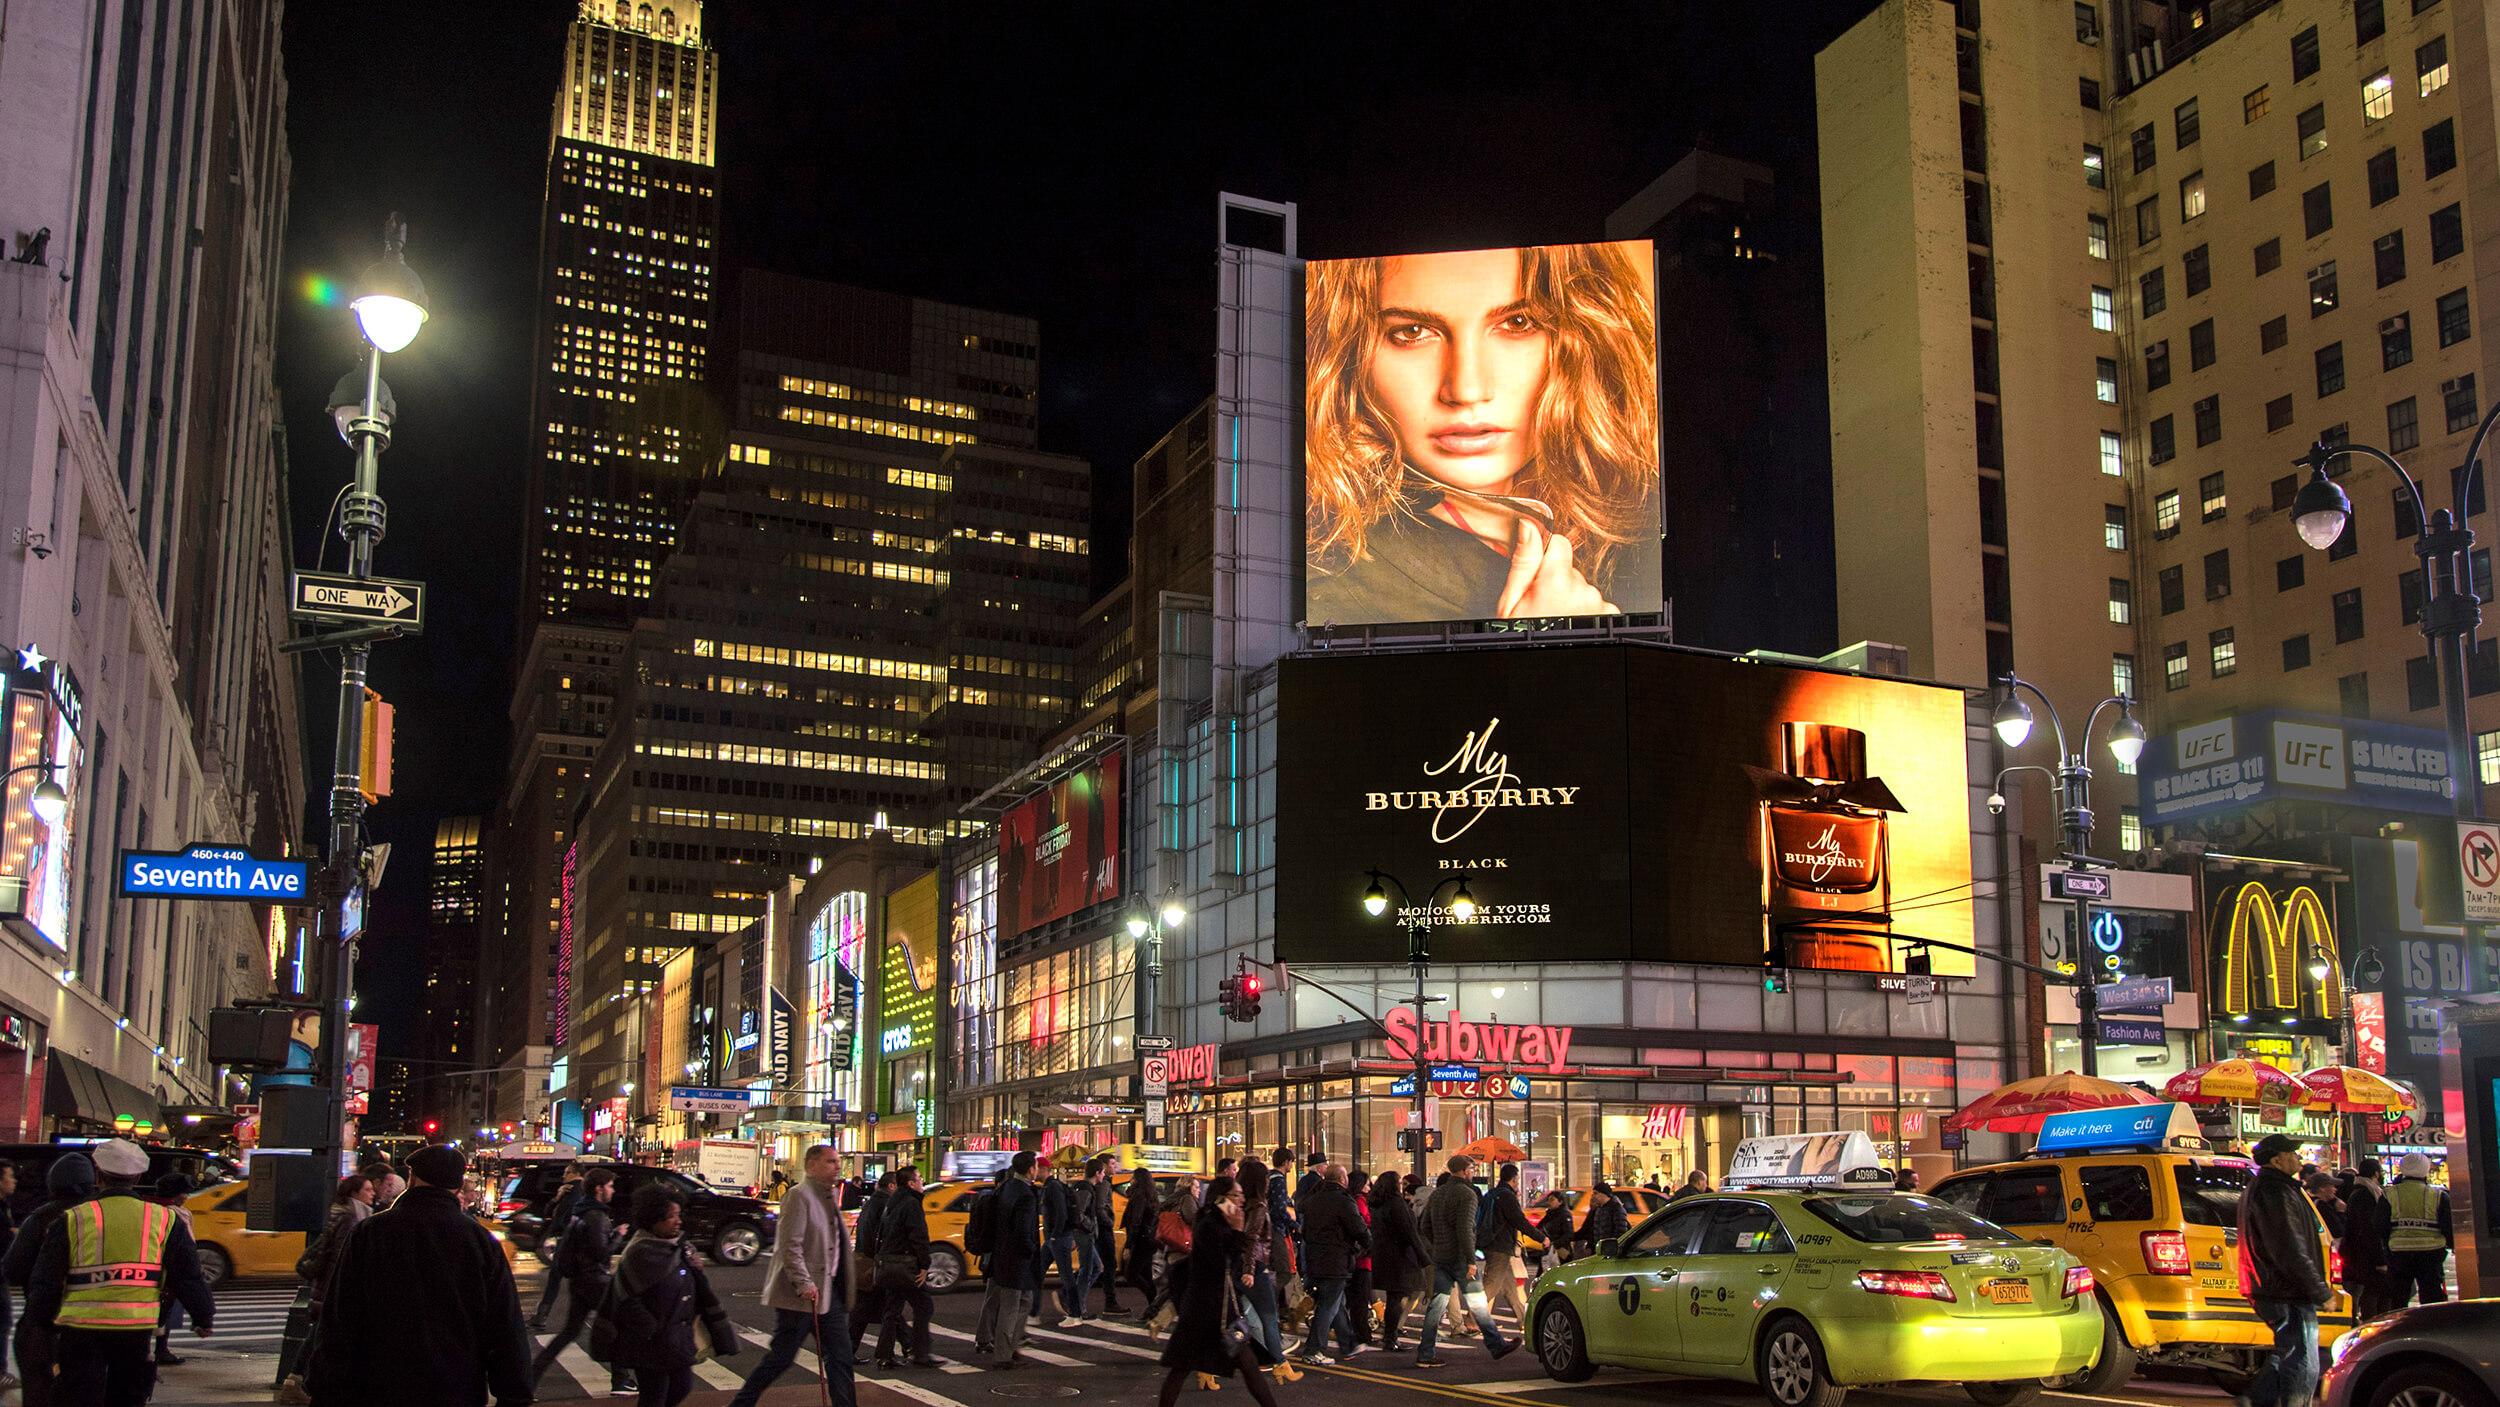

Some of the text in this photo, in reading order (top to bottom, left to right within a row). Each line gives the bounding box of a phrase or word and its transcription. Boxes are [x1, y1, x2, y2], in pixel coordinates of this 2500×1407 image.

[316, 588, 401, 609] ONE WAY
[2185, 733, 2226, 759] UFC
[2285, 741, 2334, 770] UFC
[2352, 740, 2370, 767] IS
[2371, 743, 2416, 773] BACK
[1423, 716, 1521, 844] My
[2155, 778, 2171, 800] IS
[2171, 768, 2211, 796] BACK
[2211, 762, 2240, 787] FEB
[1365, 787, 1580, 811] BURBERRY
[192, 850, 244, 862] 460 440
[1785, 853, 1867, 869] BURBERRY
[1806, 823, 1846, 883] My
[1439, 858, 1508, 869] BLACK
[133, 862, 299, 892] Seventh Ave
[1096, 854, 1115, 893] H&M
[1815, 886, 1842, 894] BLACK
[2072, 880, 2101, 890] ONE WAY
[2465, 890, 2500, 905] 7AM-7P
[1397, 904, 1551, 916] MONOGAM YOURS
[2401, 941, 2433, 989] IS
[1908, 977, 1930, 988] TURNS
[2104, 985, 2166, 1003] West 34th St
[774, 1009, 789, 1051] NAVY
[883, 1025, 912, 1053] crocs
[2105, 1025, 2161, 1040] Fashion Ave
[1384, 1007, 1574, 1075] Subway
[702, 1034, 711, 1070] KAY
[775, 1053, 789, 1083] OLD
[1157, 1043, 1215, 1087] bway
[1432, 1069, 1477, 1079] Seventh Ave
[1491, 1078, 1502, 1095] 3
[1509, 1076, 1528, 1096] MTA
[1642, 1105, 1687, 1140] H&M
[1903, 1112, 1923, 1133] H&M
[2051, 1124, 2113, 1137] Make it here.
[2134, 1115, 2154, 1131] citi
[2383, 1116, 2412, 1136] IFTS
[968, 1136, 991, 1151] H&M
[1738, 1142, 1759, 1158] SIN
[2179, 1137, 2202, 1149] 9Y62
[1733, 1153, 1761, 1168] CITY
[1855, 1169, 1879, 1181] AD989
[2068, 1221, 2096, 1233] 9Y62
[1796, 1234, 1832, 1246] AD989
[91, 1268, 147, 1282] NYPD
[1994, 1285, 2029, 1300] T652977C
